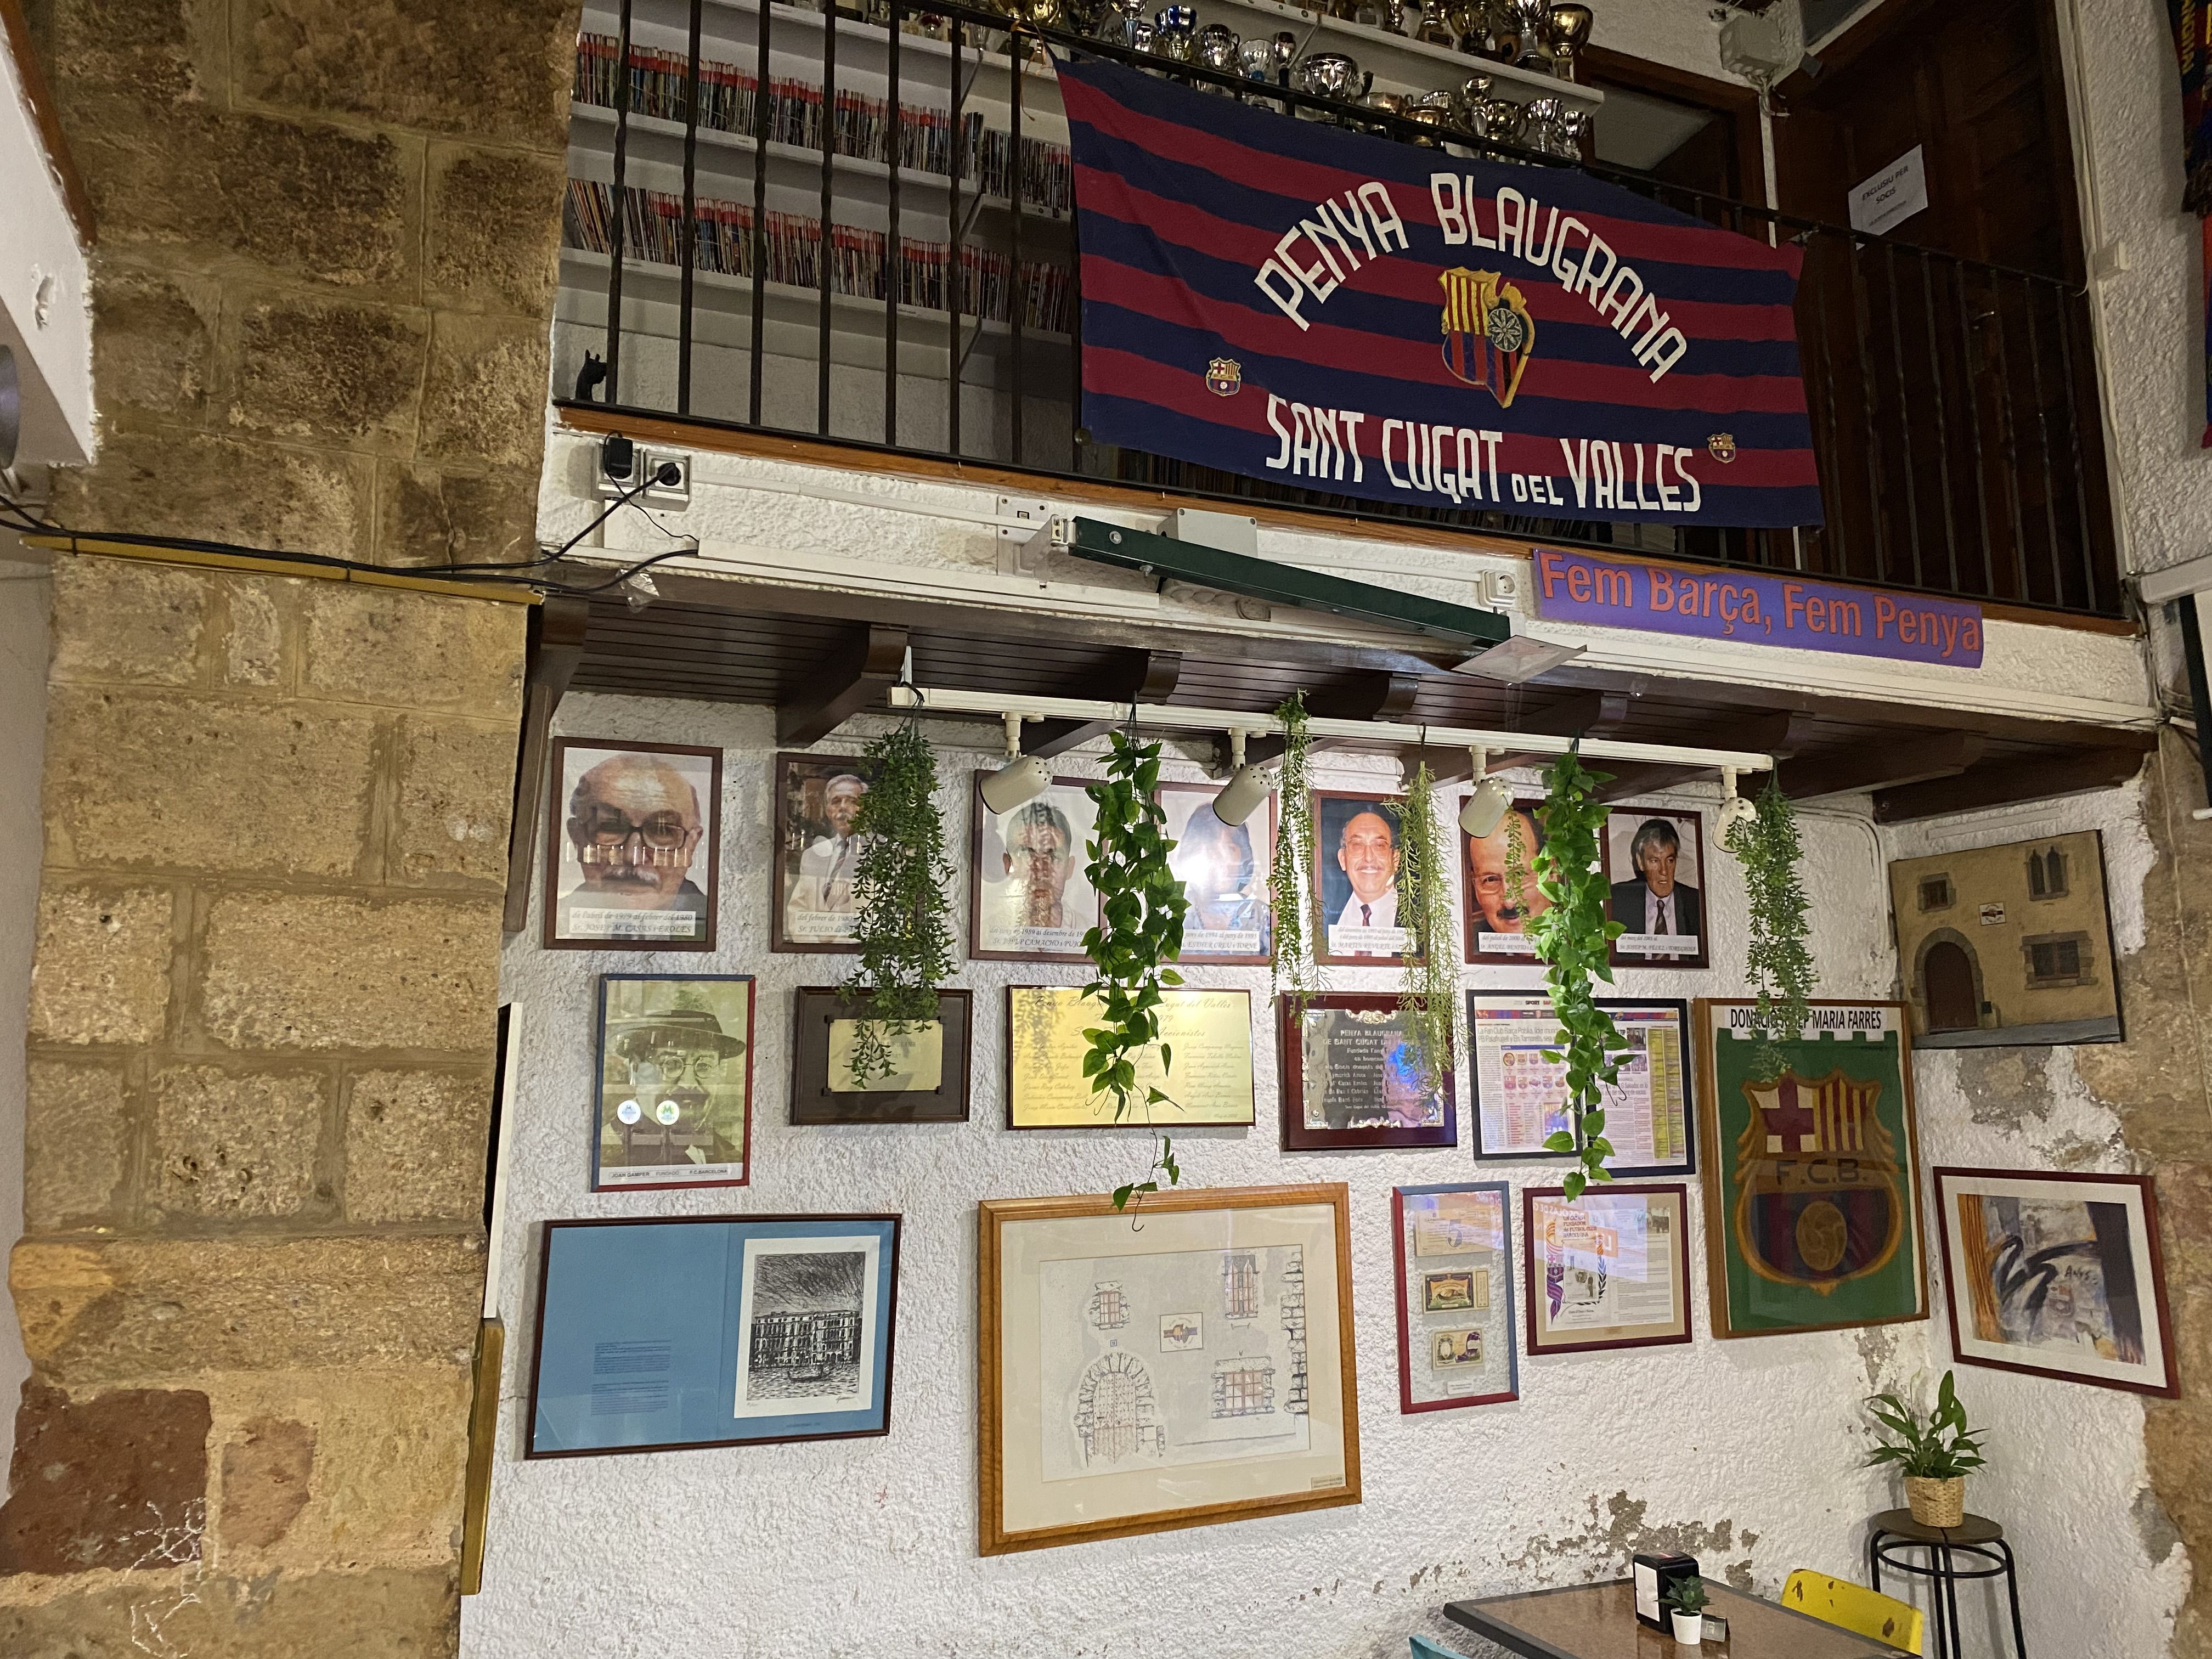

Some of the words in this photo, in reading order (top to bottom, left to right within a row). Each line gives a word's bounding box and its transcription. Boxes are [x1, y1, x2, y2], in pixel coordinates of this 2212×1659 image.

[1862, 175, 1894, 201] EXCLUSIU
[1895, 166, 1909, 179] PER
[1875, 187, 1896, 204] SOCIS
[1254, 181, 1410, 331] PENYA
[1430, 172, 1688, 383] BLAUGRANA
[1265, 393, 1364, 483] SANT
[1381, 418, 1504, 504] CUGAT
[1512, 473, 1564, 507] DEL
[1559, 437, 1702, 513] VALLES
[1538, 552, 1633, 608] Fem
[1648, 567, 1771, 635] Barça,
[1781, 582, 1862, 637] Fem
[1873, 595, 1980, 658] Penya
[1813, 1010, 1845, 1029] MARIA
[1447, 1218, 1463, 1248] 5
